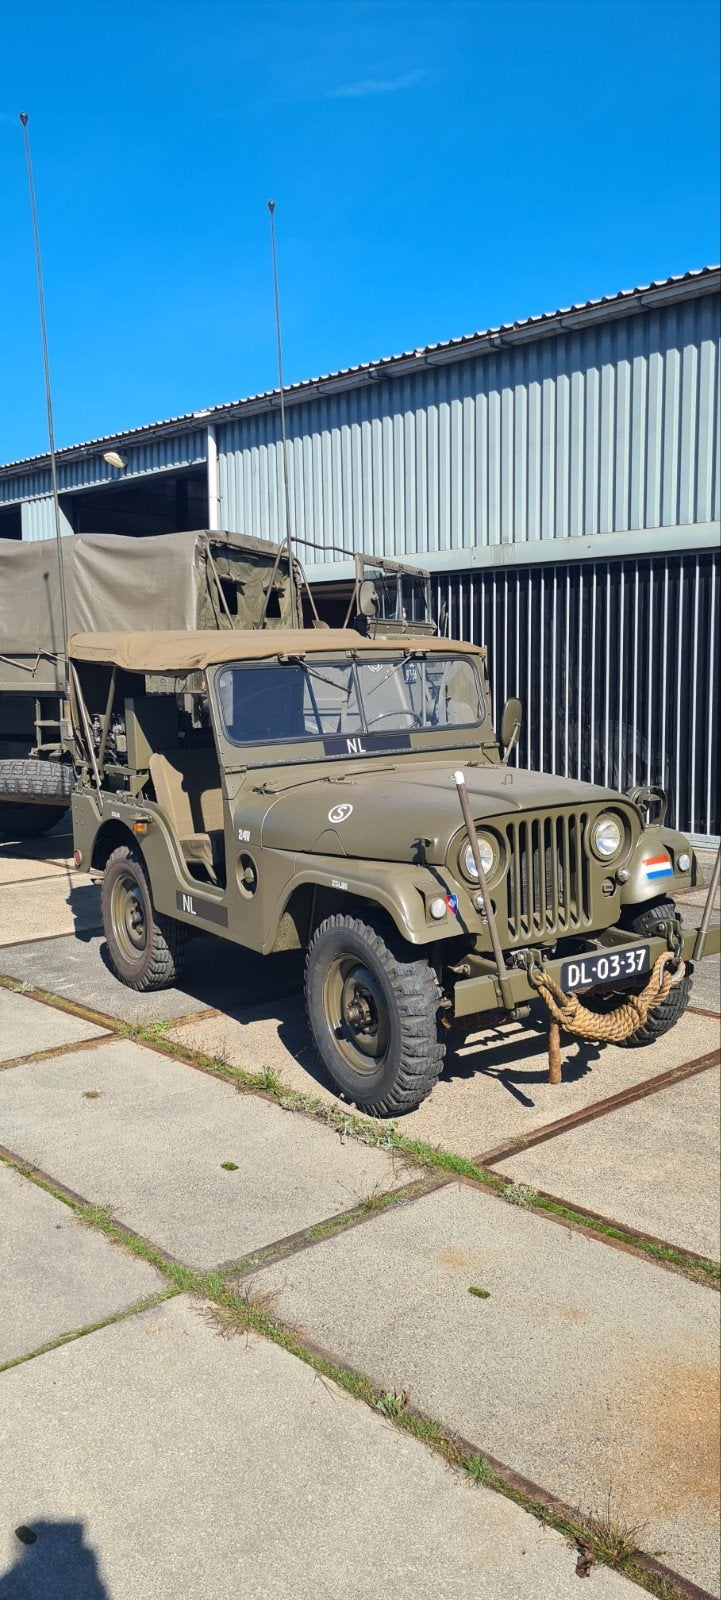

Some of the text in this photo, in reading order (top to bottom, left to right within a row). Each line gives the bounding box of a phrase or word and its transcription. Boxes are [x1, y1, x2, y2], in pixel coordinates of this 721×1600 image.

[346, 738, 366, 753] NL
[238, 829, 251, 841] 24V
[182, 894, 197, 915] NL
